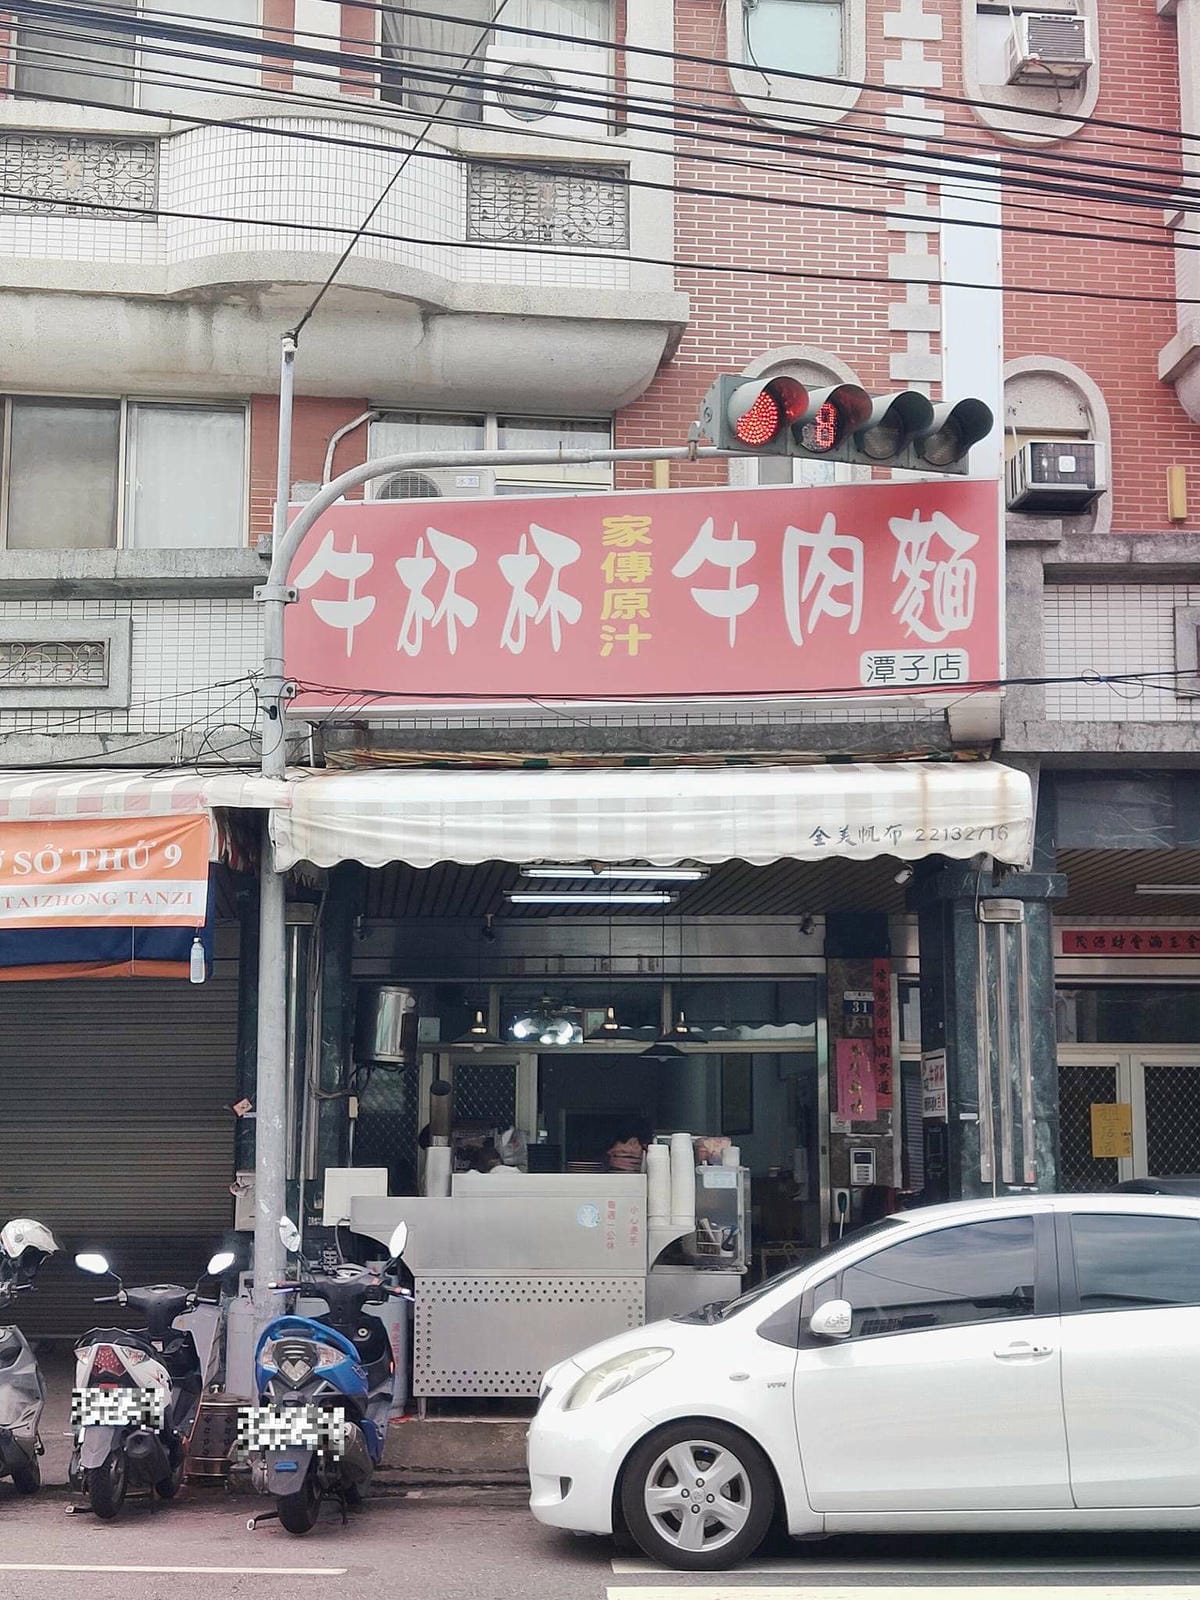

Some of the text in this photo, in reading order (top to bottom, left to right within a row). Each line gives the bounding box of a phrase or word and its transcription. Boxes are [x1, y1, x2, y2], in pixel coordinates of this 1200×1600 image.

[294, 523, 583, 658] 牛杯杯
[600, 515, 653, 657] 家傳原汁
[671, 508, 980, 648] 牛肉麵
[866, 654, 962, 683] 潭子店
[162, 843, 183, 869] 9
[1, 891, 192, 911] TAIZHONG TANZI
[852, 1001, 868, 1013] 31
